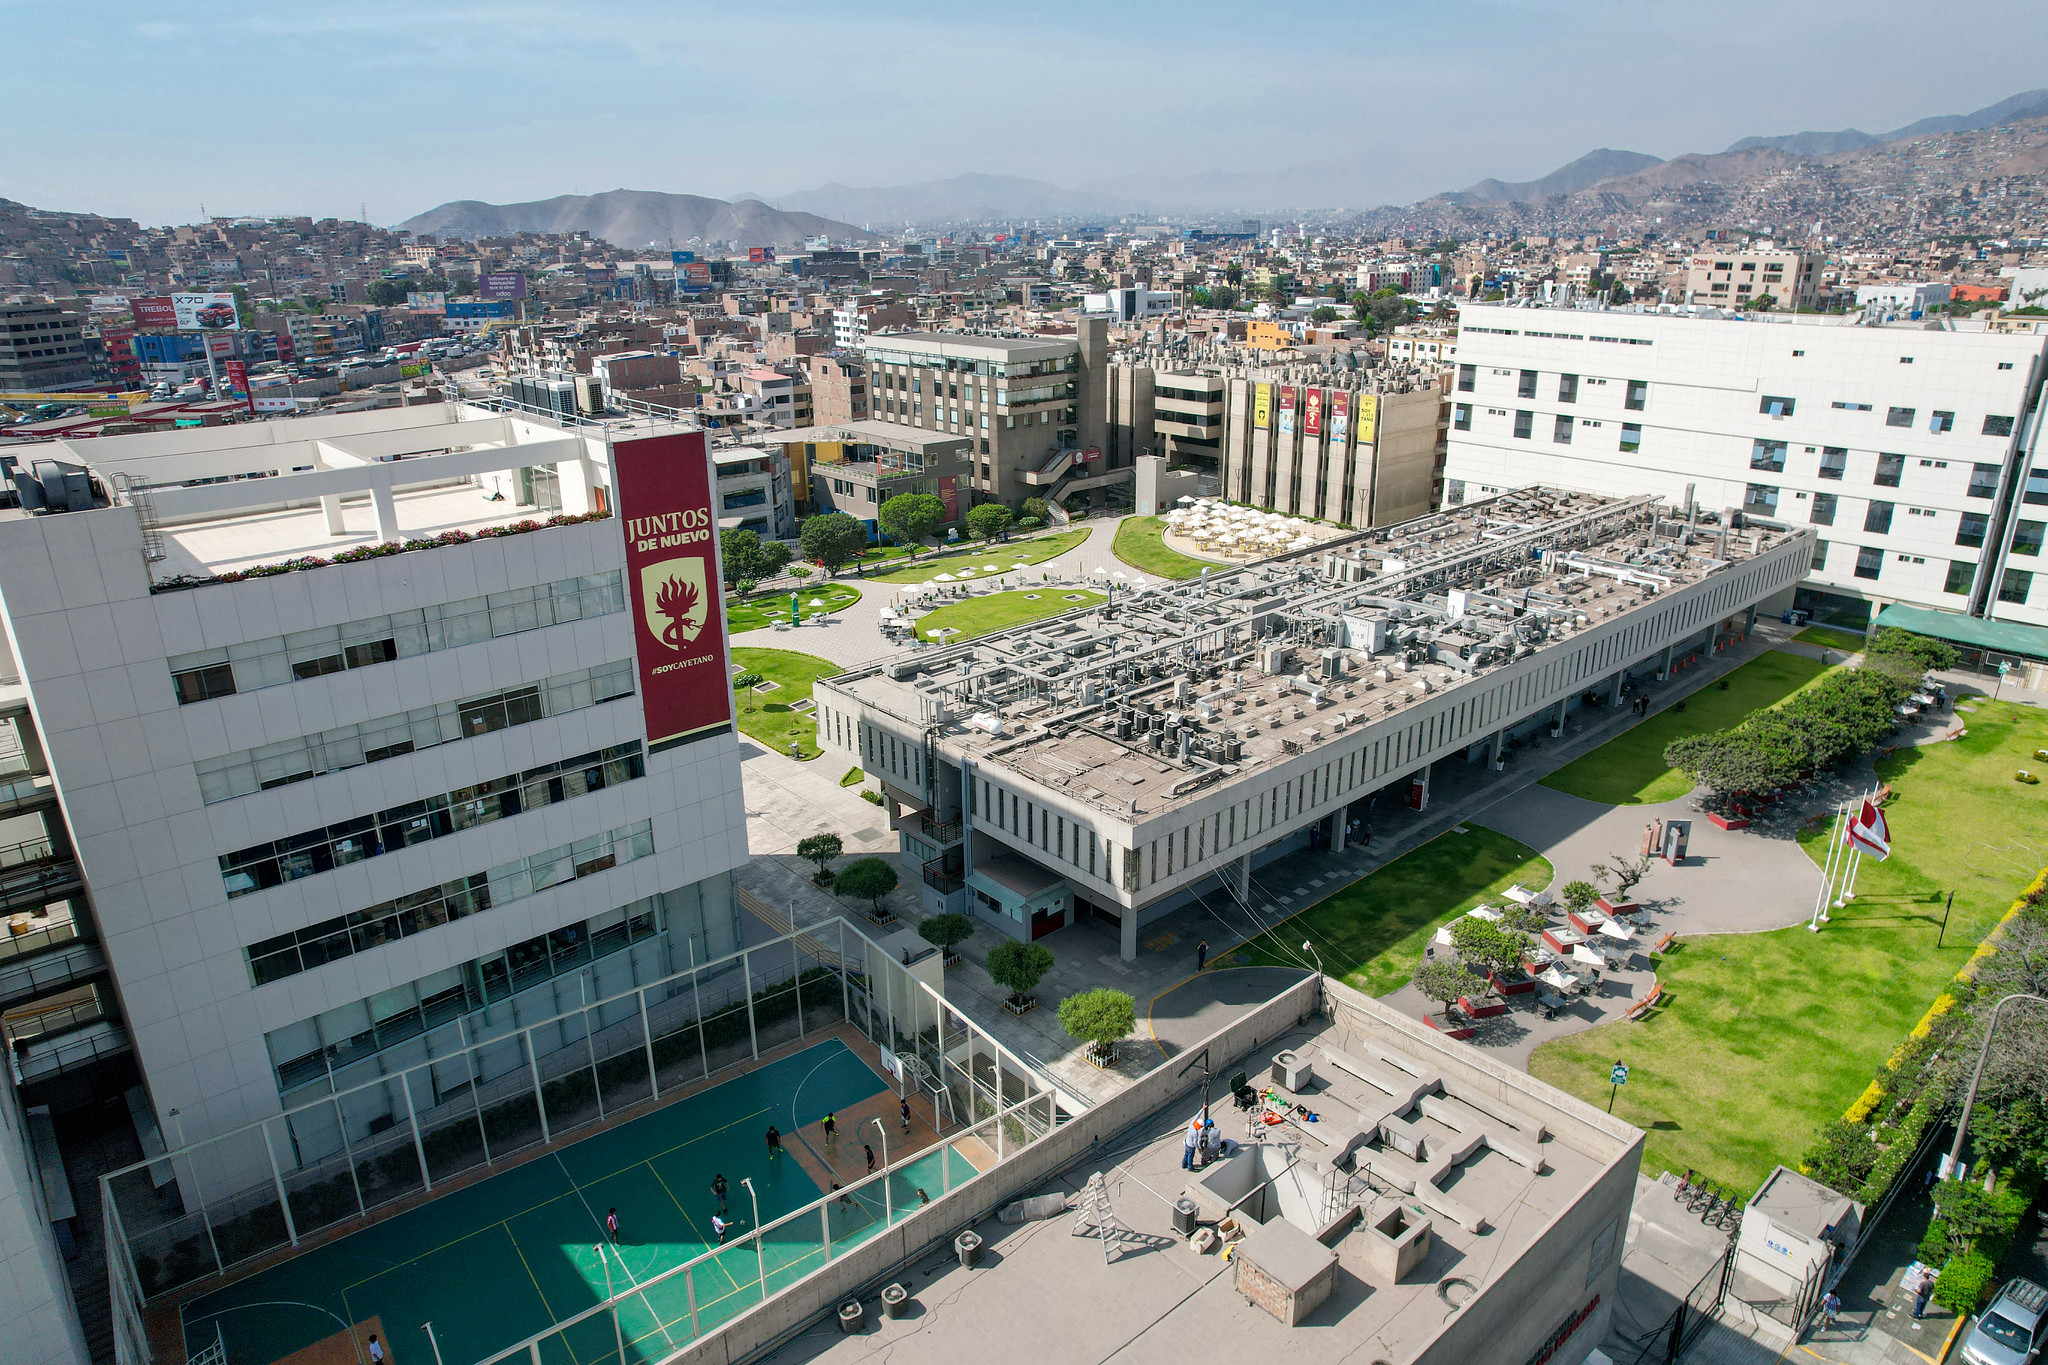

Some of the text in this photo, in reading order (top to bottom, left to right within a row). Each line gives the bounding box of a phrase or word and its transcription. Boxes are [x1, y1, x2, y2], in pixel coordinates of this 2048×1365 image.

[627, 507, 709, 544] JUNTOS
[637, 528, 710, 553] DE NUEVO
[651, 654, 714, 675] #SOYCAYETANO
